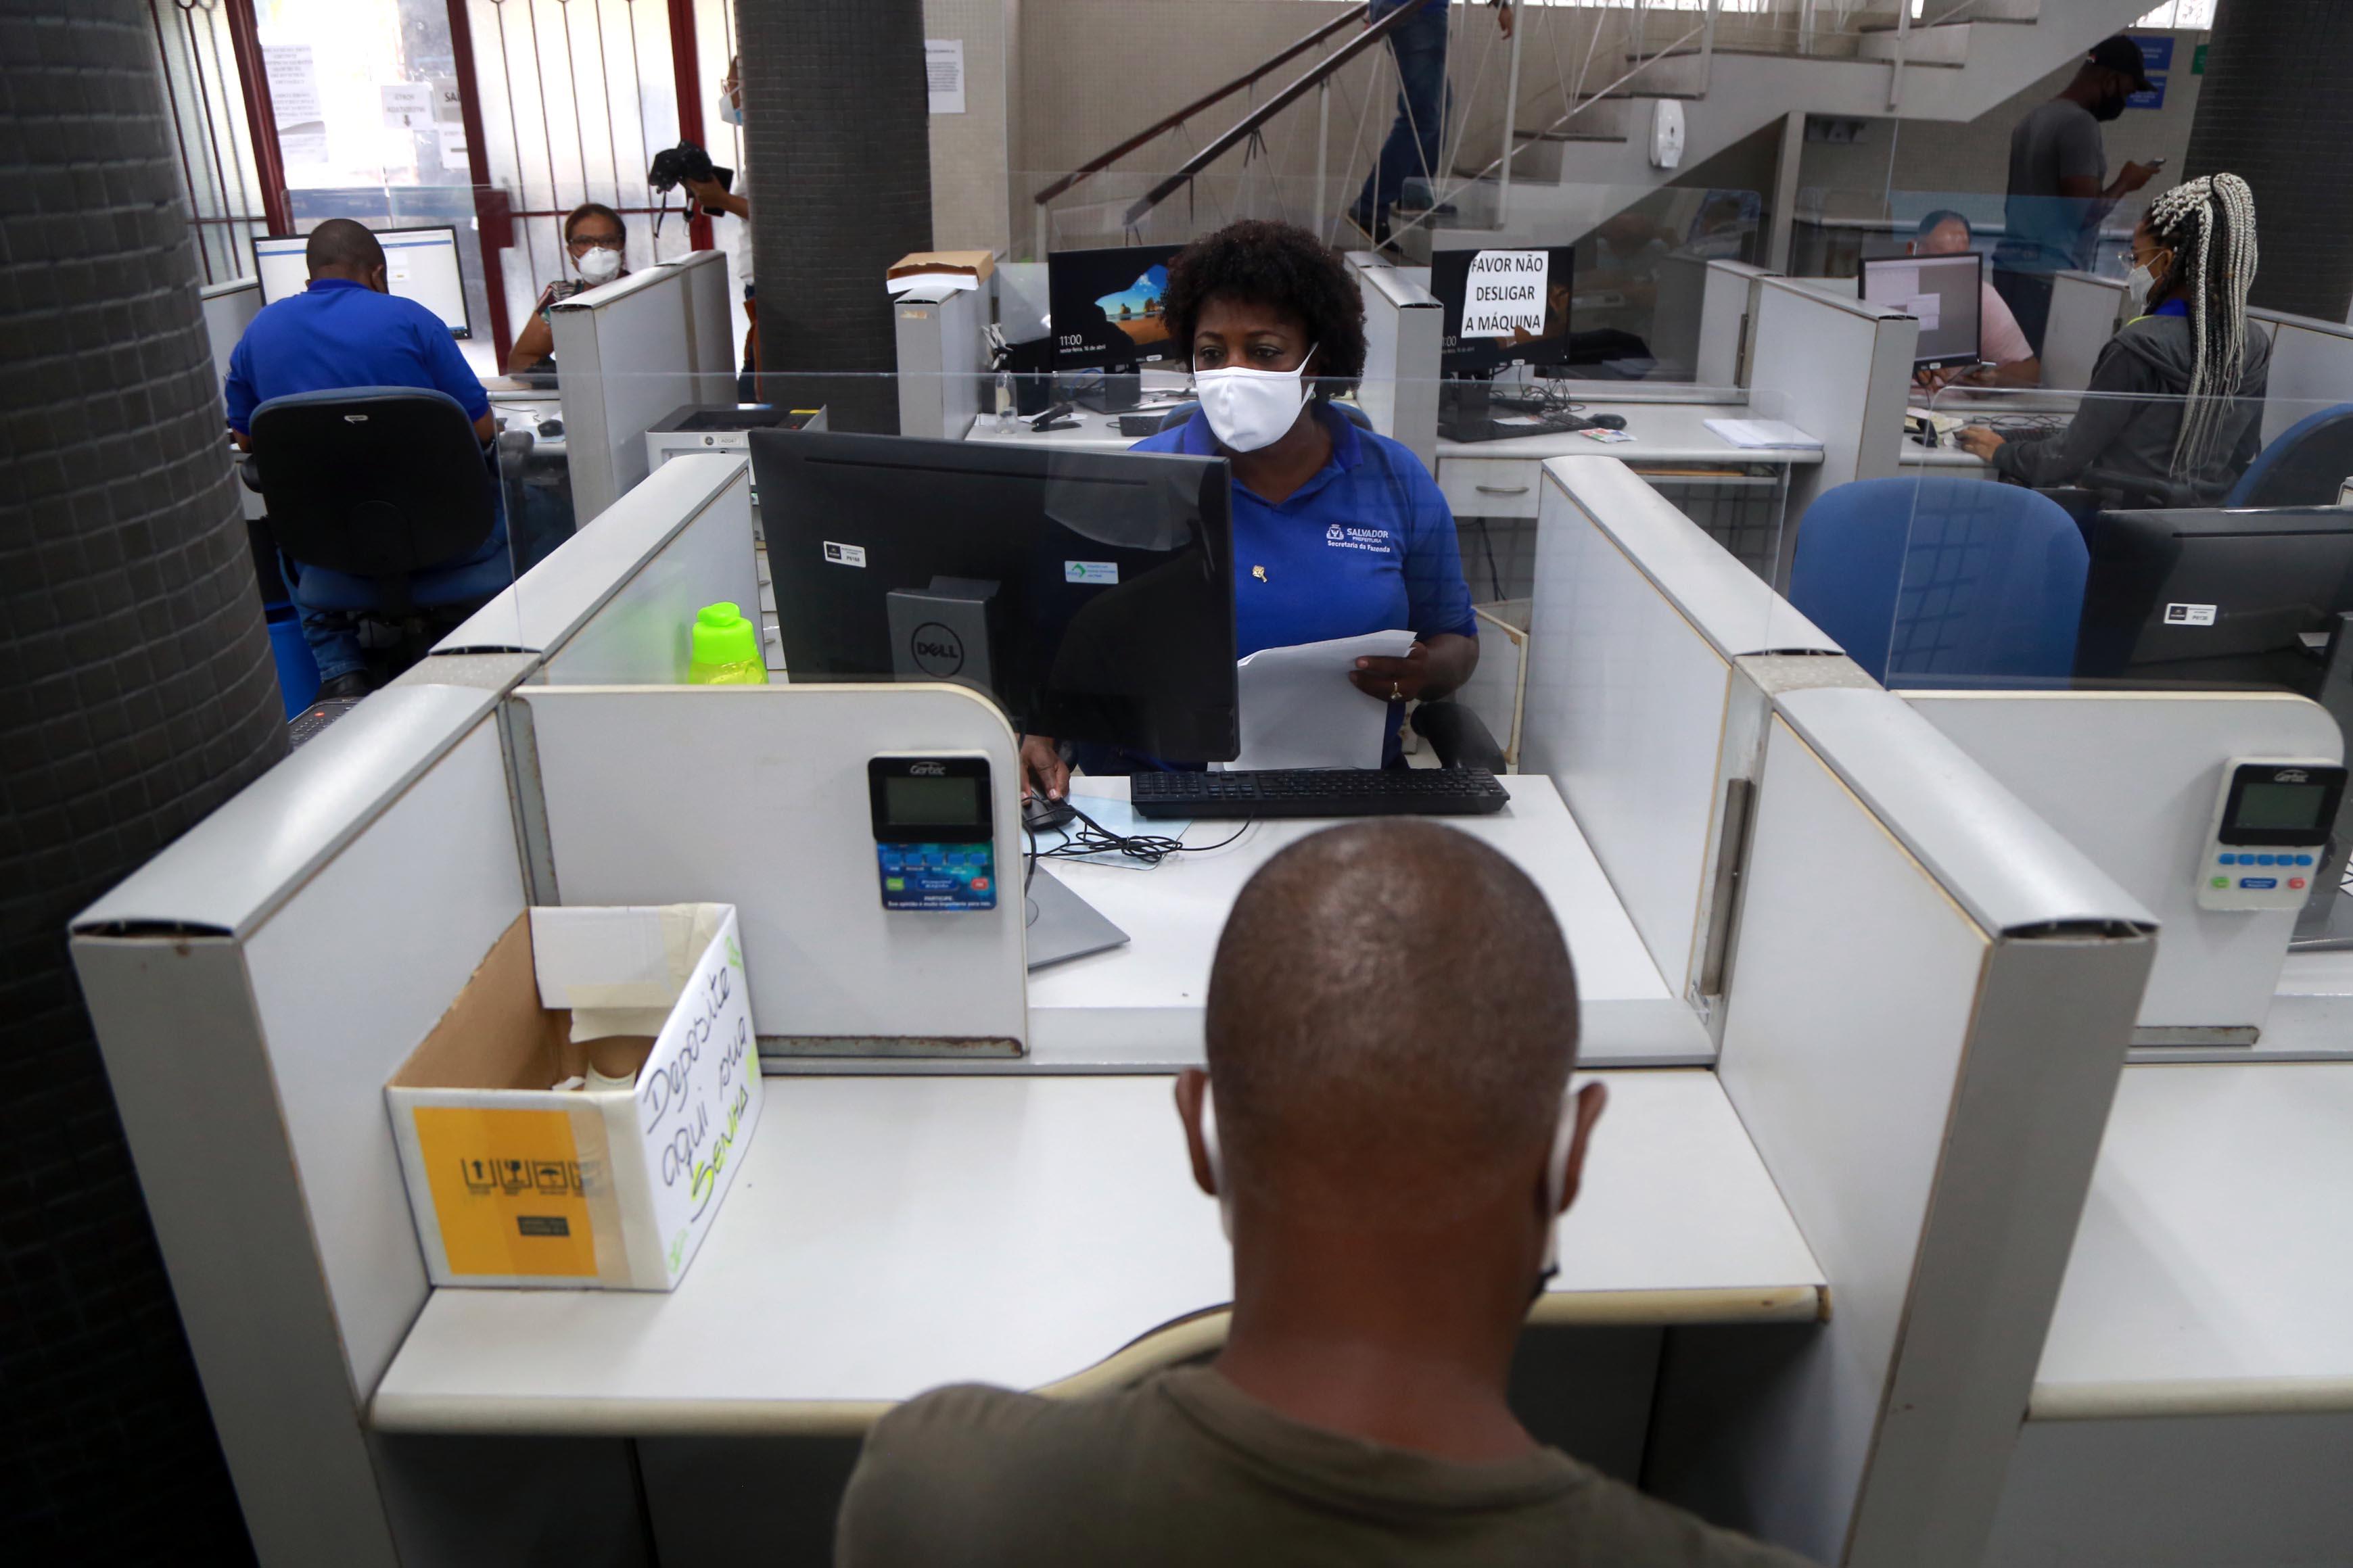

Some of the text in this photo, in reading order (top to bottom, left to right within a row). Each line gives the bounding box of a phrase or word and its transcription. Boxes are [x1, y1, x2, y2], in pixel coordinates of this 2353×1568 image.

[1471, 254, 1543, 272] FAVOR NÃO
[1476, 286, 1535, 302] DESLIGAR
[1465, 311, 1540, 331] A MÁQUINA
[1059, 334, 1082, 346] 11:00
[1347, 528, 1389, 538] SALVADOR
[1327, 540, 1358, 548] Secretaria
[1367, 544, 1391, 552] Fazenda
[917, 642, 958, 659] DELL
[910, 763, 946, 776] Gertec
[643, 966, 730, 1135] Deposite
[662, 1086, 708, 1187] aqui
